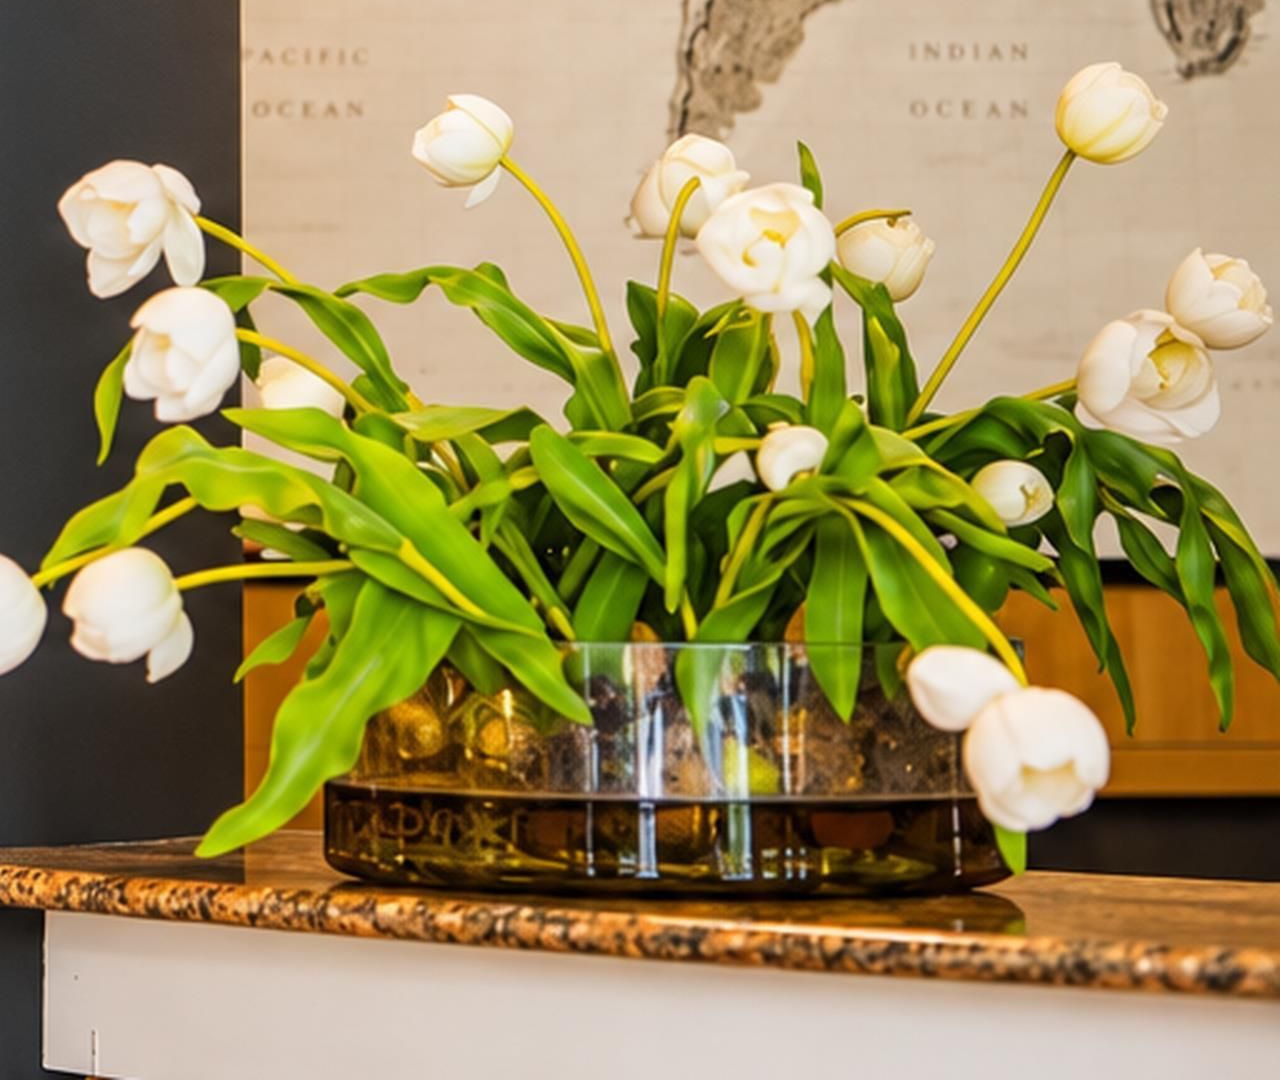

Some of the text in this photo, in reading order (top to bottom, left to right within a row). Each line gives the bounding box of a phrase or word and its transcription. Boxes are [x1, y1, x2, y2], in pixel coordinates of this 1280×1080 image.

[909, 42, 1028, 61] INDIAN
[251, 99, 364, 119] OCEAN
[909, 100, 1029, 119] OCEAN
